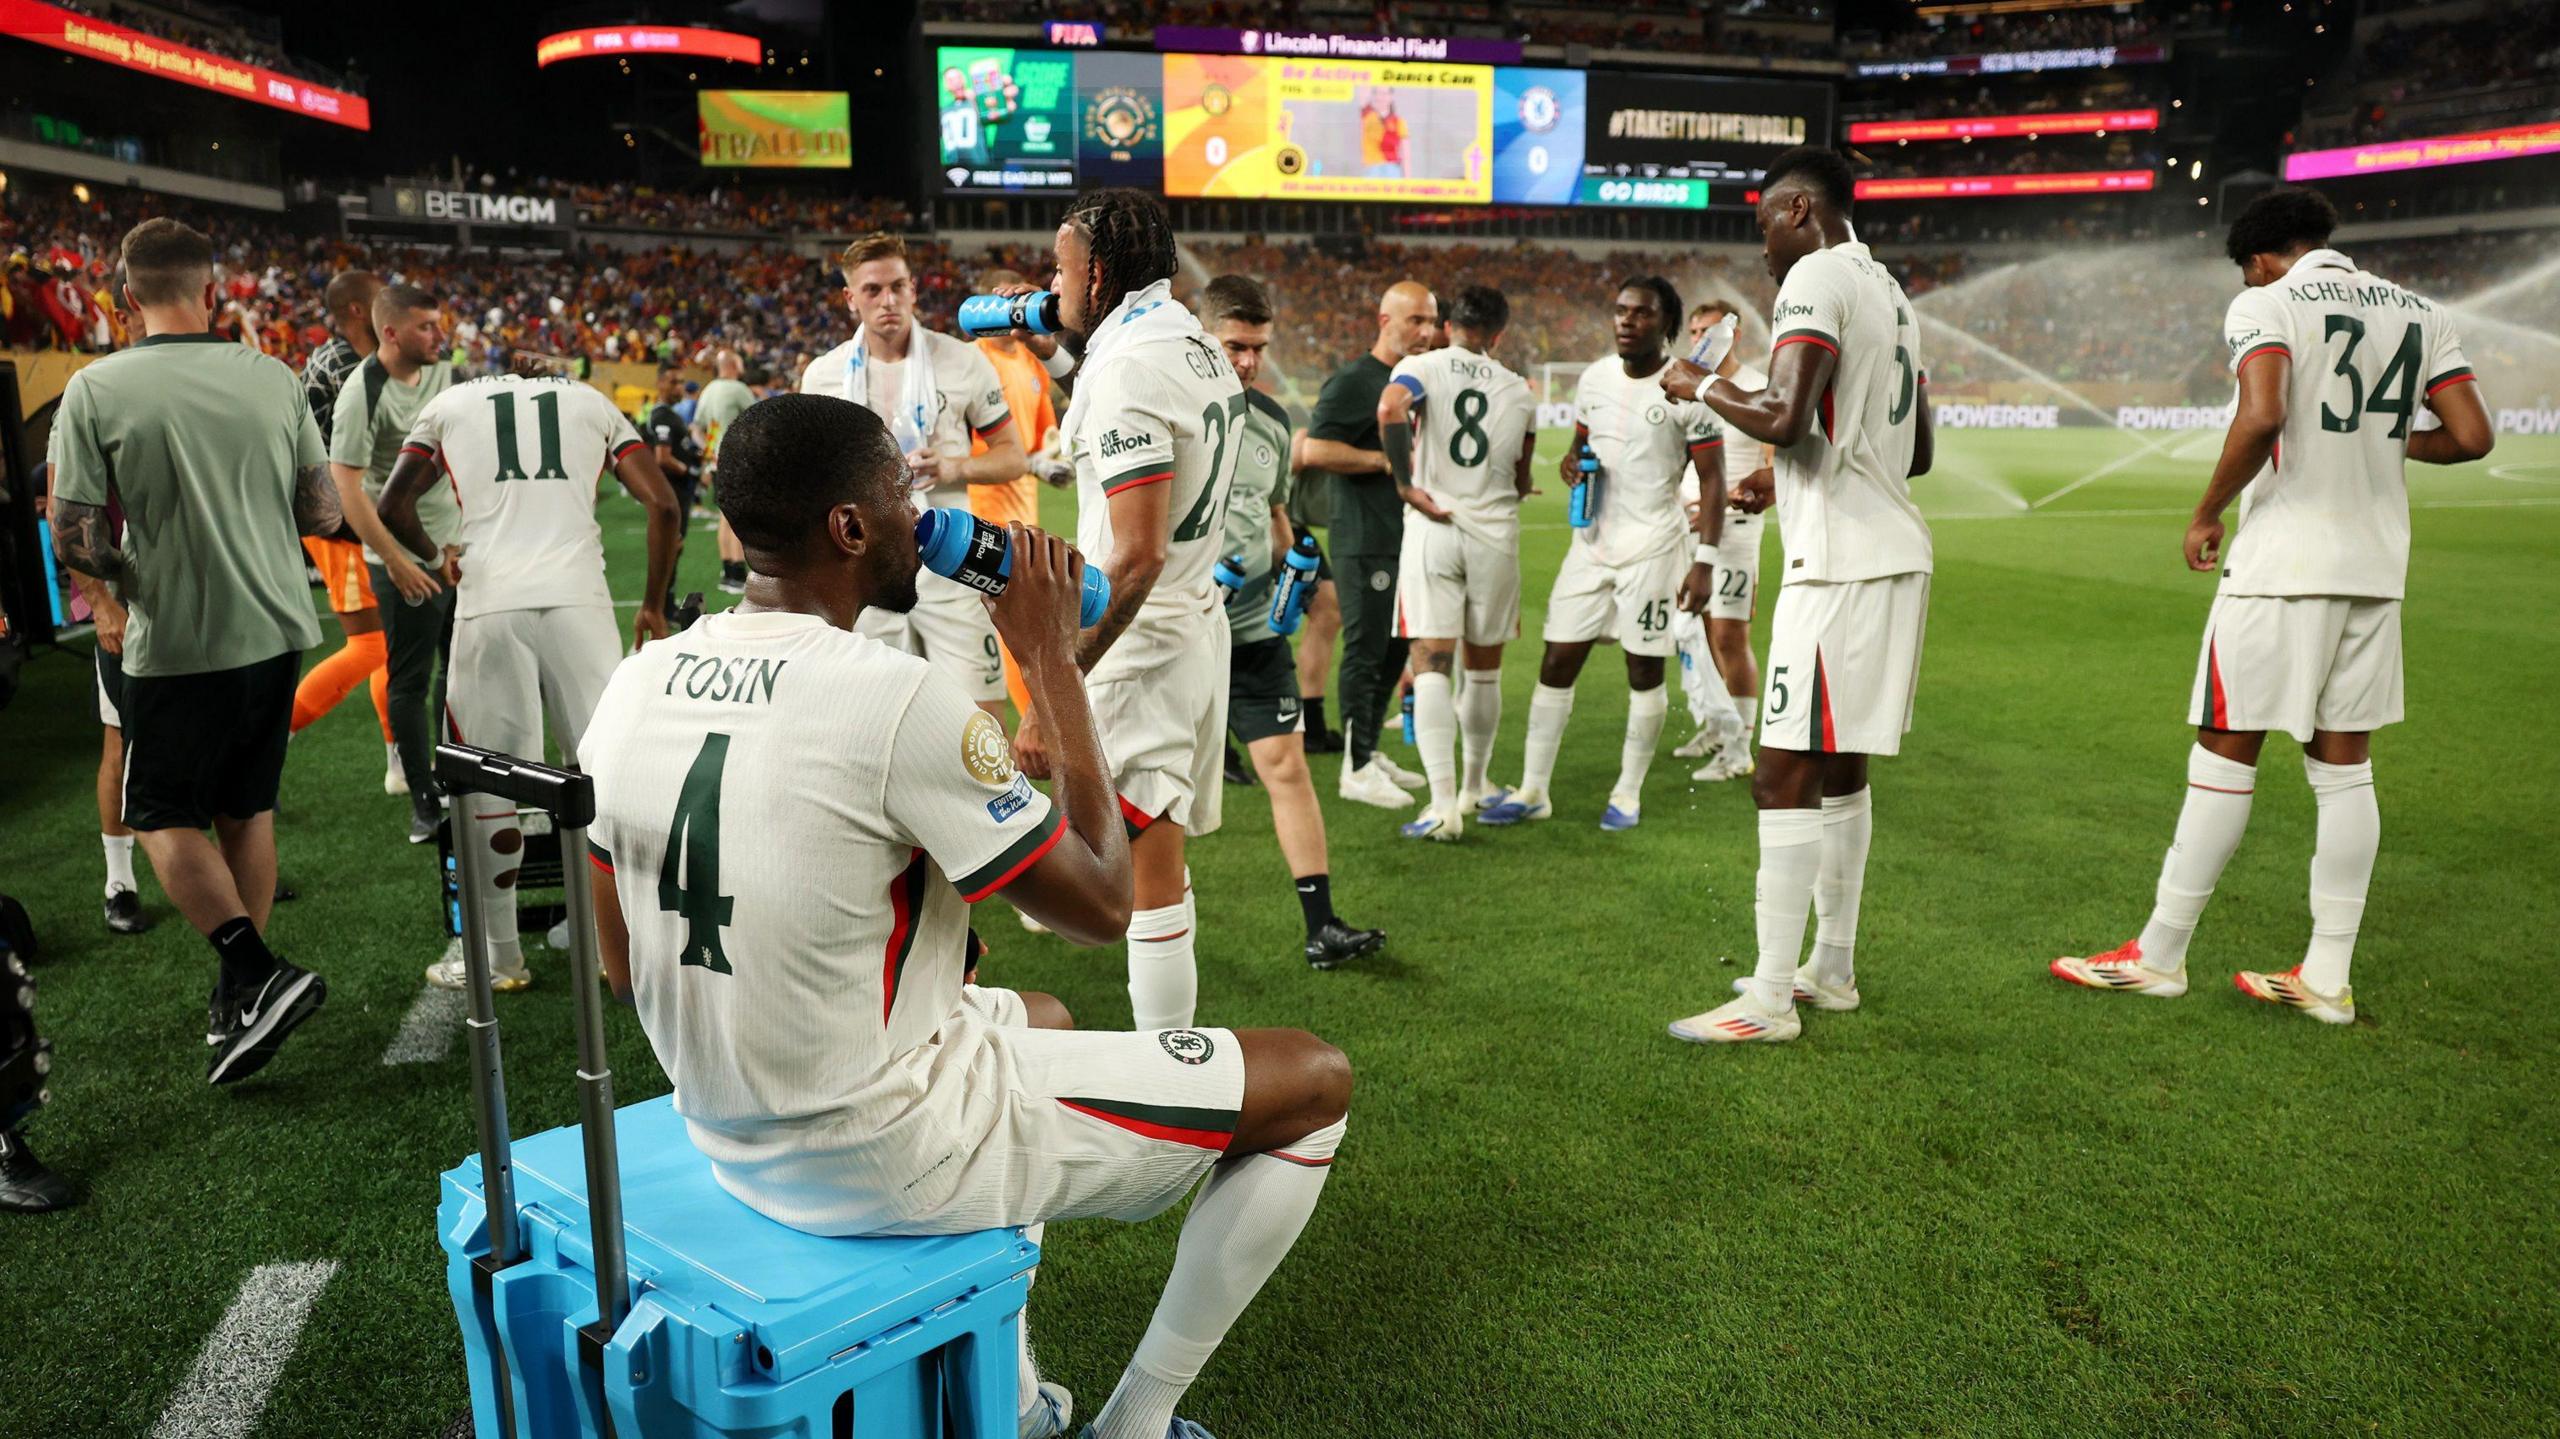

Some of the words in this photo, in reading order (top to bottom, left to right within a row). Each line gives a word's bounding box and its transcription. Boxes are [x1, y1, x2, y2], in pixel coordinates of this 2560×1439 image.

[1051, 23, 1098, 45] FIFA
[1264, 32, 1328, 53] Lincoln
[1329, 34, 1404, 57] Financial
[1405, 37, 1447, 59] Field
[1311, 67, 1370, 81] Active
[1382, 69, 1434, 83] Dance
[1440, 71, 1475, 85] Cam
[1608, 108, 1806, 145] #TAKEITTOTHEWORLD
[1205, 136, 1228, 167] 0
[1528, 145, 1548, 174] 0
[972, 171, 1001, 185] FREE
[1599, 181, 1632, 201] GO
[1633, 182, 1690, 204] BIRDS
[425, 190, 557, 224] BETMGM
[1450, 358, 1492, 379] ENZO
[2322, 314, 2422, 440] 34
[1449, 389, 1489, 468] 8
[1936, 404, 2059, 428] POWERADE
[2117, 405, 2234, 430] POWERAD
[486, 391, 569, 482] 11
[1099, 429, 1119, 447] LIVE
[1101, 433, 1152, 458] NATION
[976, 531, 990, 560] POWER
[1719, 568, 1748, 599] 22
[1638, 599, 1668, 632] 45
[665, 652, 787, 705] TOSIN
[1770, 665, 1790, 714] 5
[658, 732, 735, 976] 4
